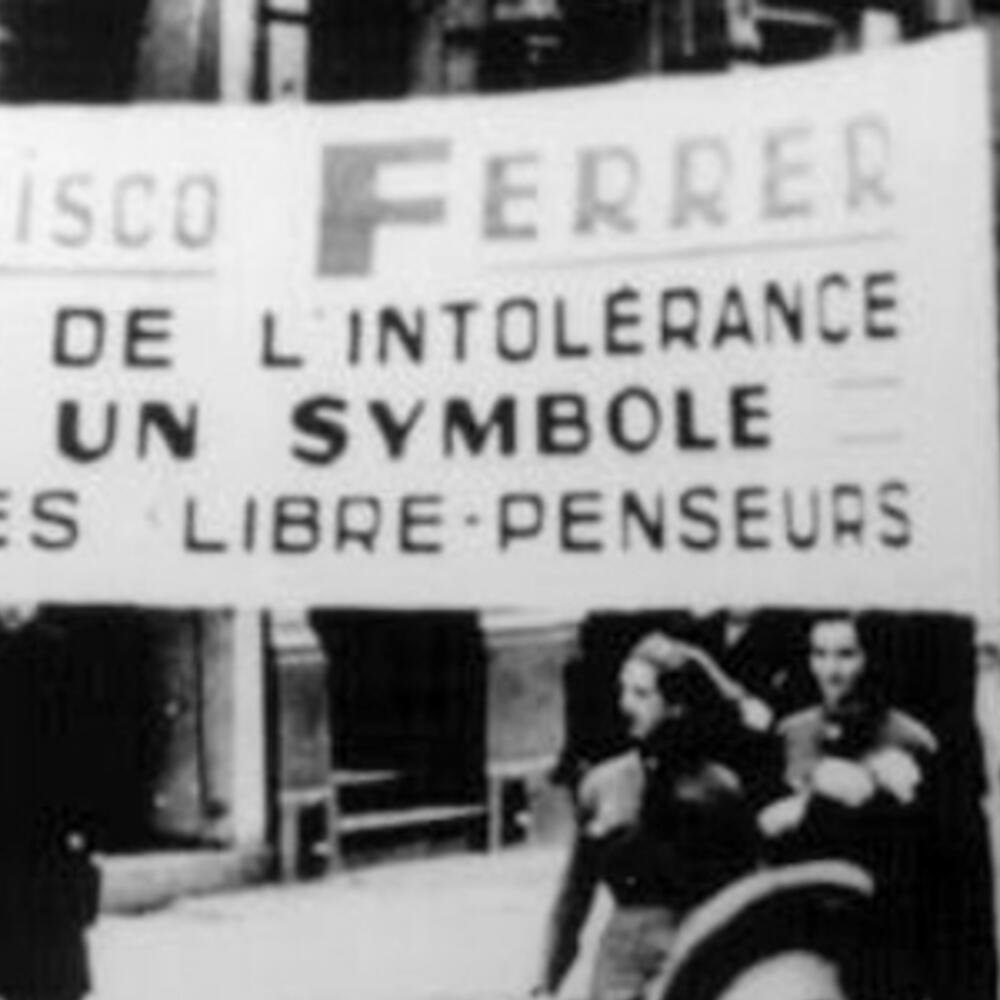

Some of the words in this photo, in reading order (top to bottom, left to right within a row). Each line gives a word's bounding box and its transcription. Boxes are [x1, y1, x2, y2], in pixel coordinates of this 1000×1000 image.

[313, 112, 898, 281] FERRER
[52, 306, 173, 370] DE
[56, 399, 199, 465] UN
[291, 383, 771, 468] SYMBOLE
[0, 488, 80, 552] S
[184, 481, 912, 556] LIBRE-PENSEURS
